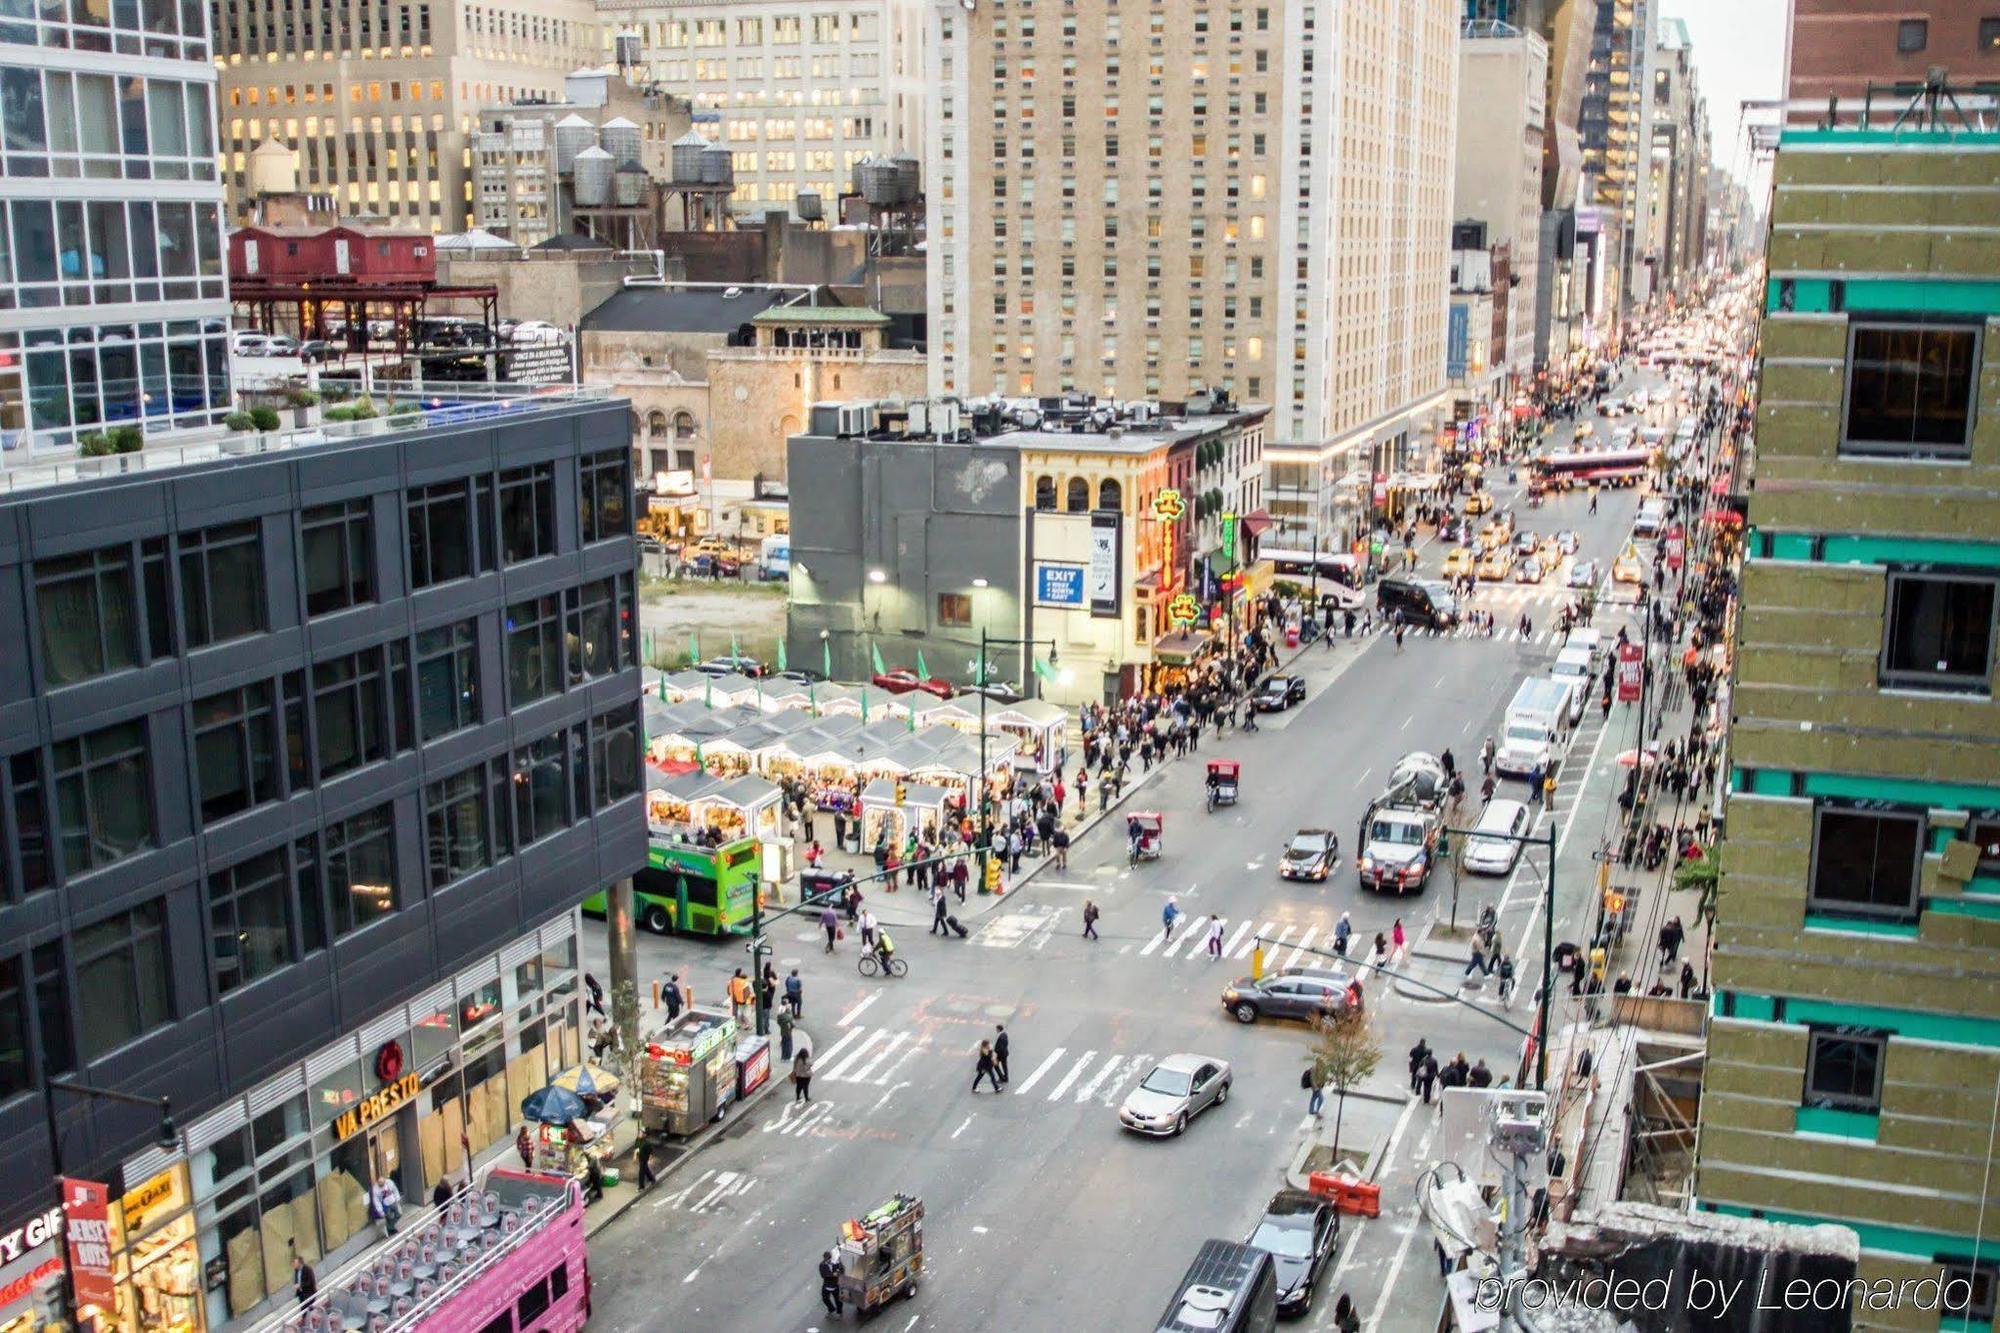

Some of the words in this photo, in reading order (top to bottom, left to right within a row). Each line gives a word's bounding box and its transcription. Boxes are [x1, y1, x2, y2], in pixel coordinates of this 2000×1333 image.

[1046, 570, 1076, 582] EXIT
[334, 1111, 359, 1141] VA
[360, 1072, 421, 1126] PRESTO
[68, 1218, 109, 1242] JERSEY
[77, 1244, 109, 1266] BOYS
